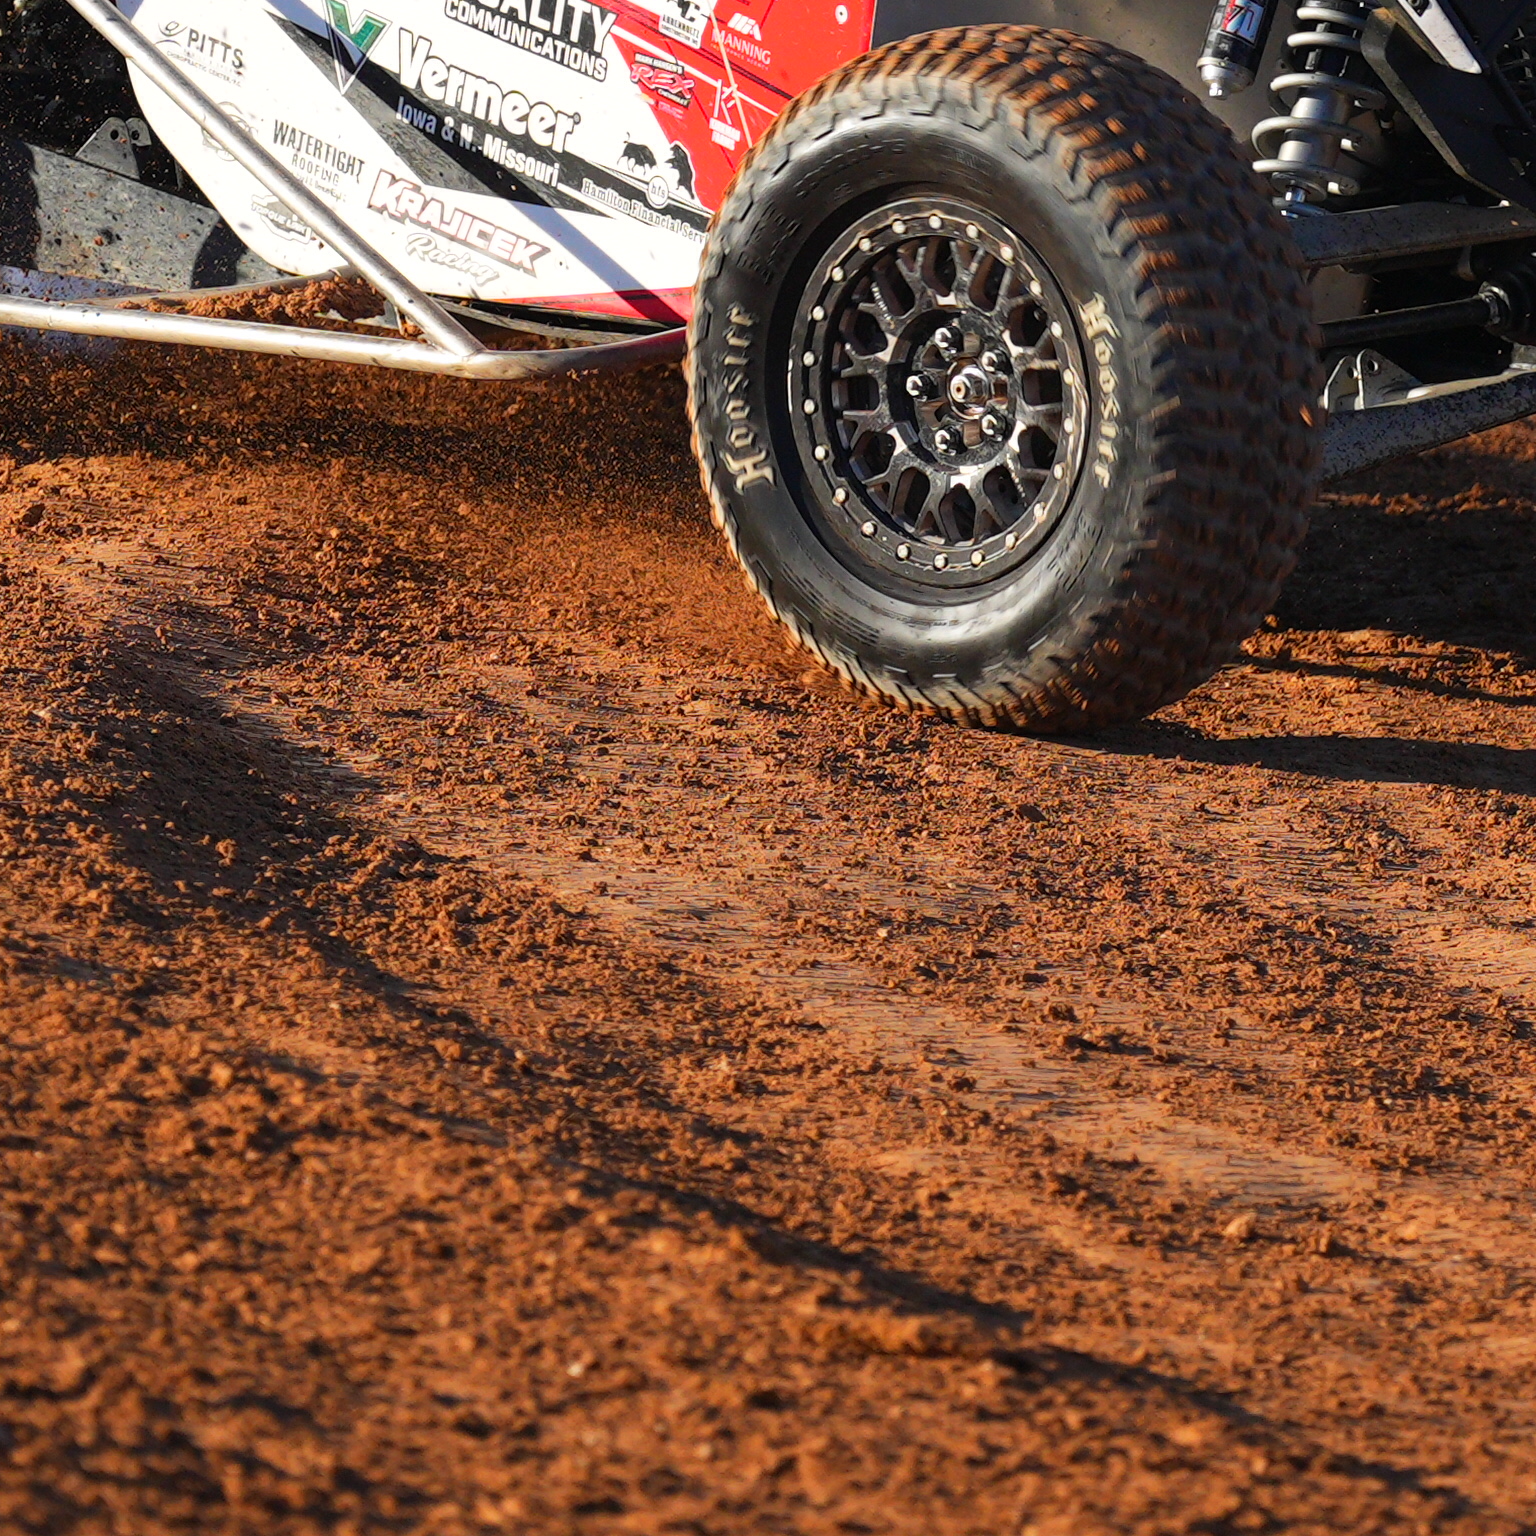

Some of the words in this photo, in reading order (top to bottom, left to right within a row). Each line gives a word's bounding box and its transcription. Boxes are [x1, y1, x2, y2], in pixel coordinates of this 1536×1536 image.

[187, 27, 244, 70] PITTS
[711, 28, 772, 65] MANNING
[399, 27, 576, 153] Vermeer
[630, 63, 695, 100] REX
[273, 119, 366, 185] WATERTIGHT
[291, 152, 340, 187] ROOFING
[395, 95, 438, 135] Iowa
[440, 116, 456, 143] &
[482, 133, 560, 187] Missouri
[368, 168, 549, 274] KRAJICEK
[583, 177, 631, 211] Hamilton
[631, 199, 682, 234] Financial
[405, 232, 500, 286] Racing
[720, 302, 777, 495] Hoosier
[1078, 291, 1122, 489] Hoosier
